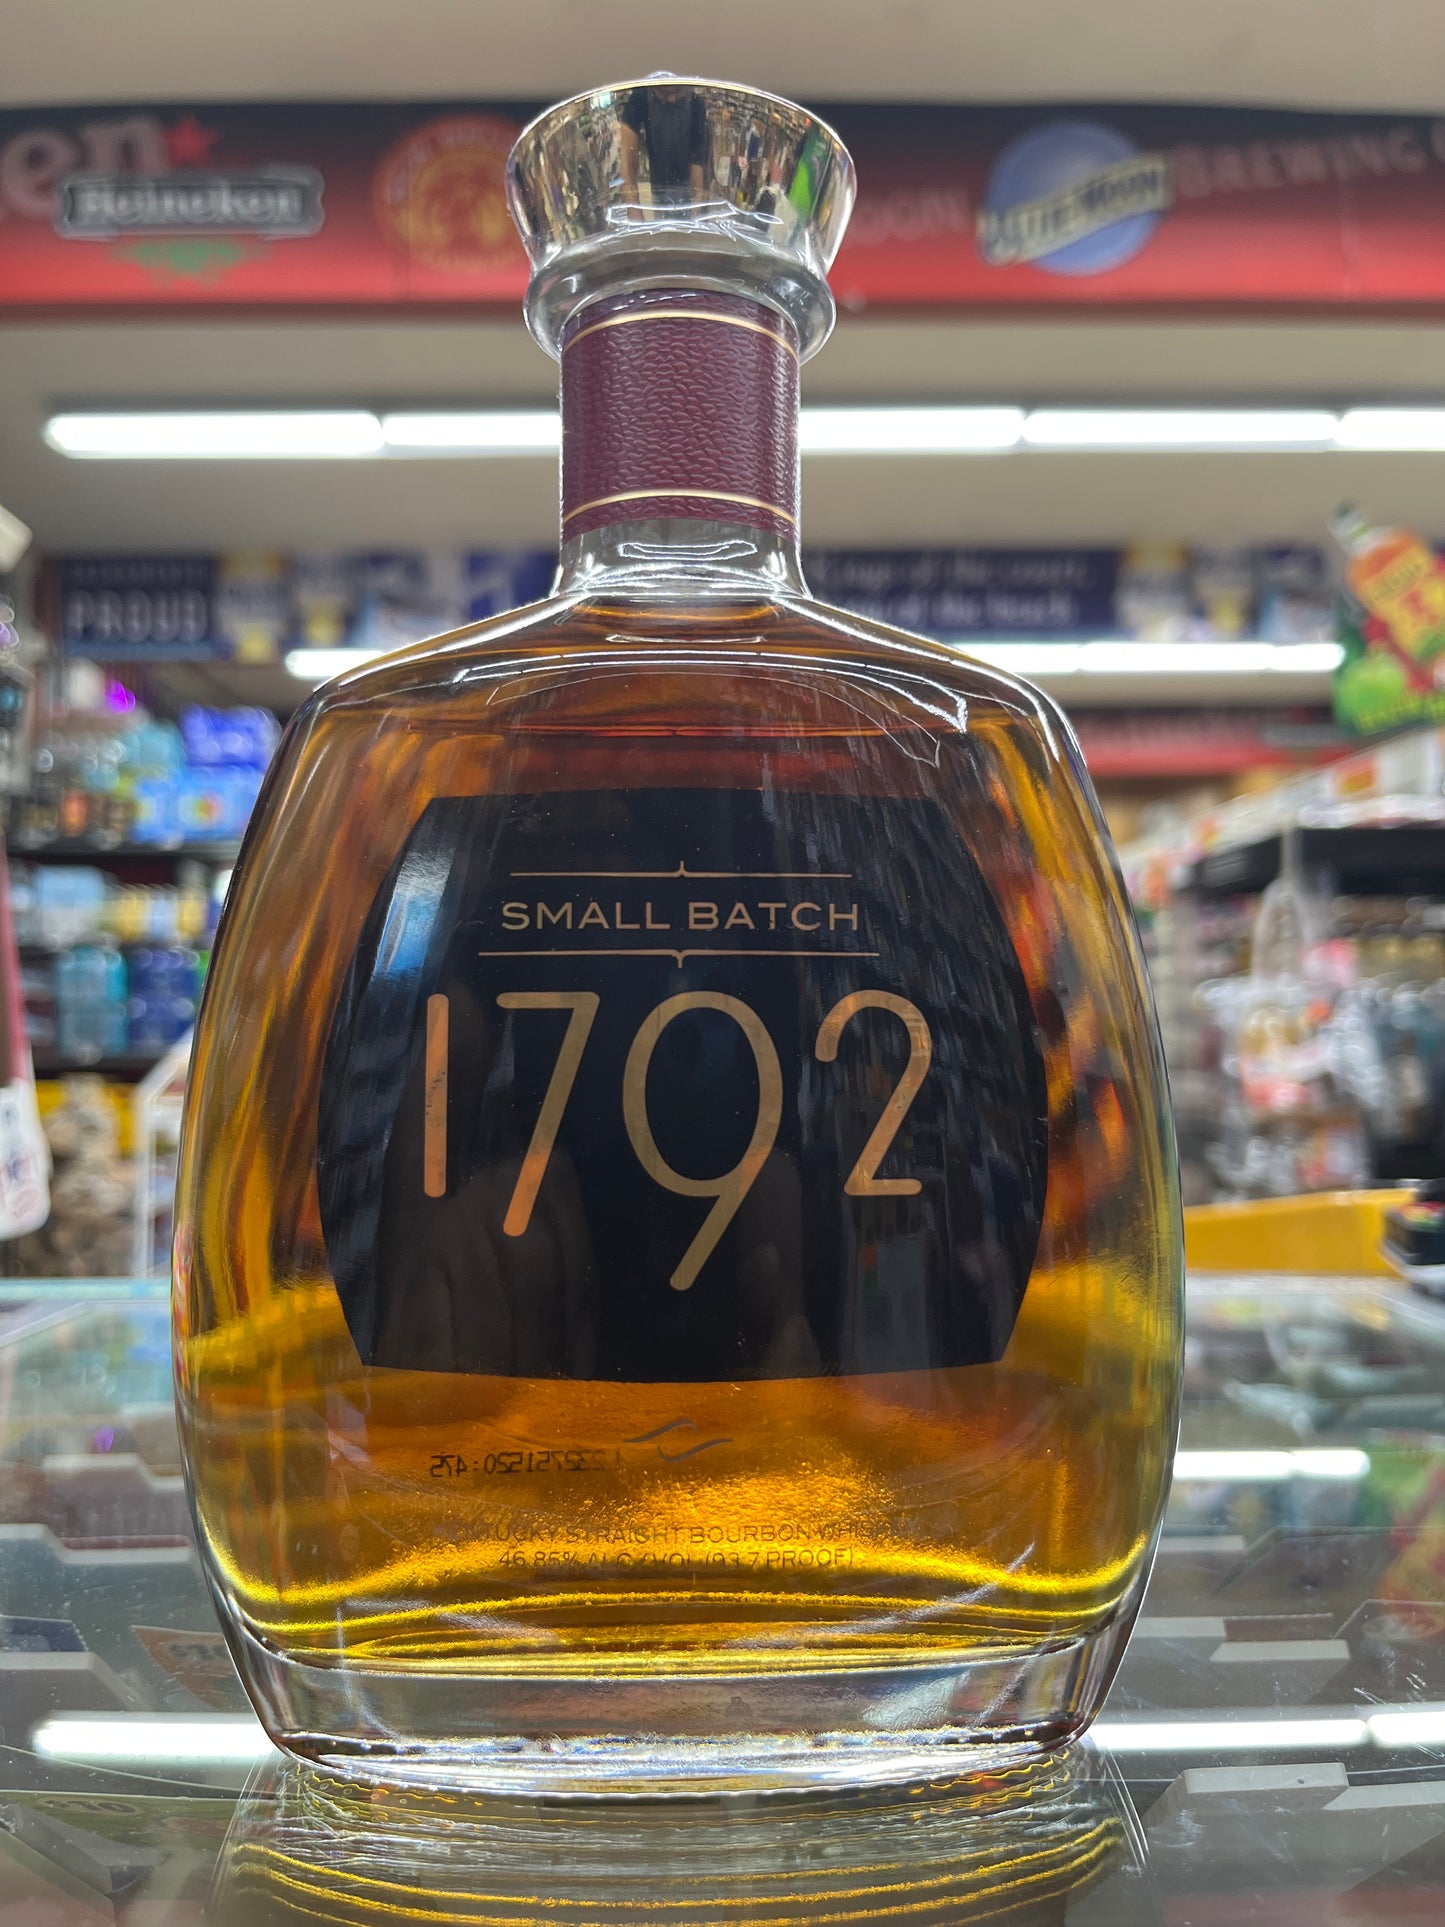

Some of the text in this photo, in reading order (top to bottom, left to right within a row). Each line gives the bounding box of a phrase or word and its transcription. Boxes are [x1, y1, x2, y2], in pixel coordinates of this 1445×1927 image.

[82, 180, 299, 226] Heineken
[67, 591, 208, 640] PROUD
[501, 901, 859, 931] SMALL BATCH
[423, 989, 932, 1291] 1792
[690, 1524, 812, 1544] BOURBON
[499, 1550, 578, 1568] 4685%
[766, 1547, 854, 1569] PROOF)
